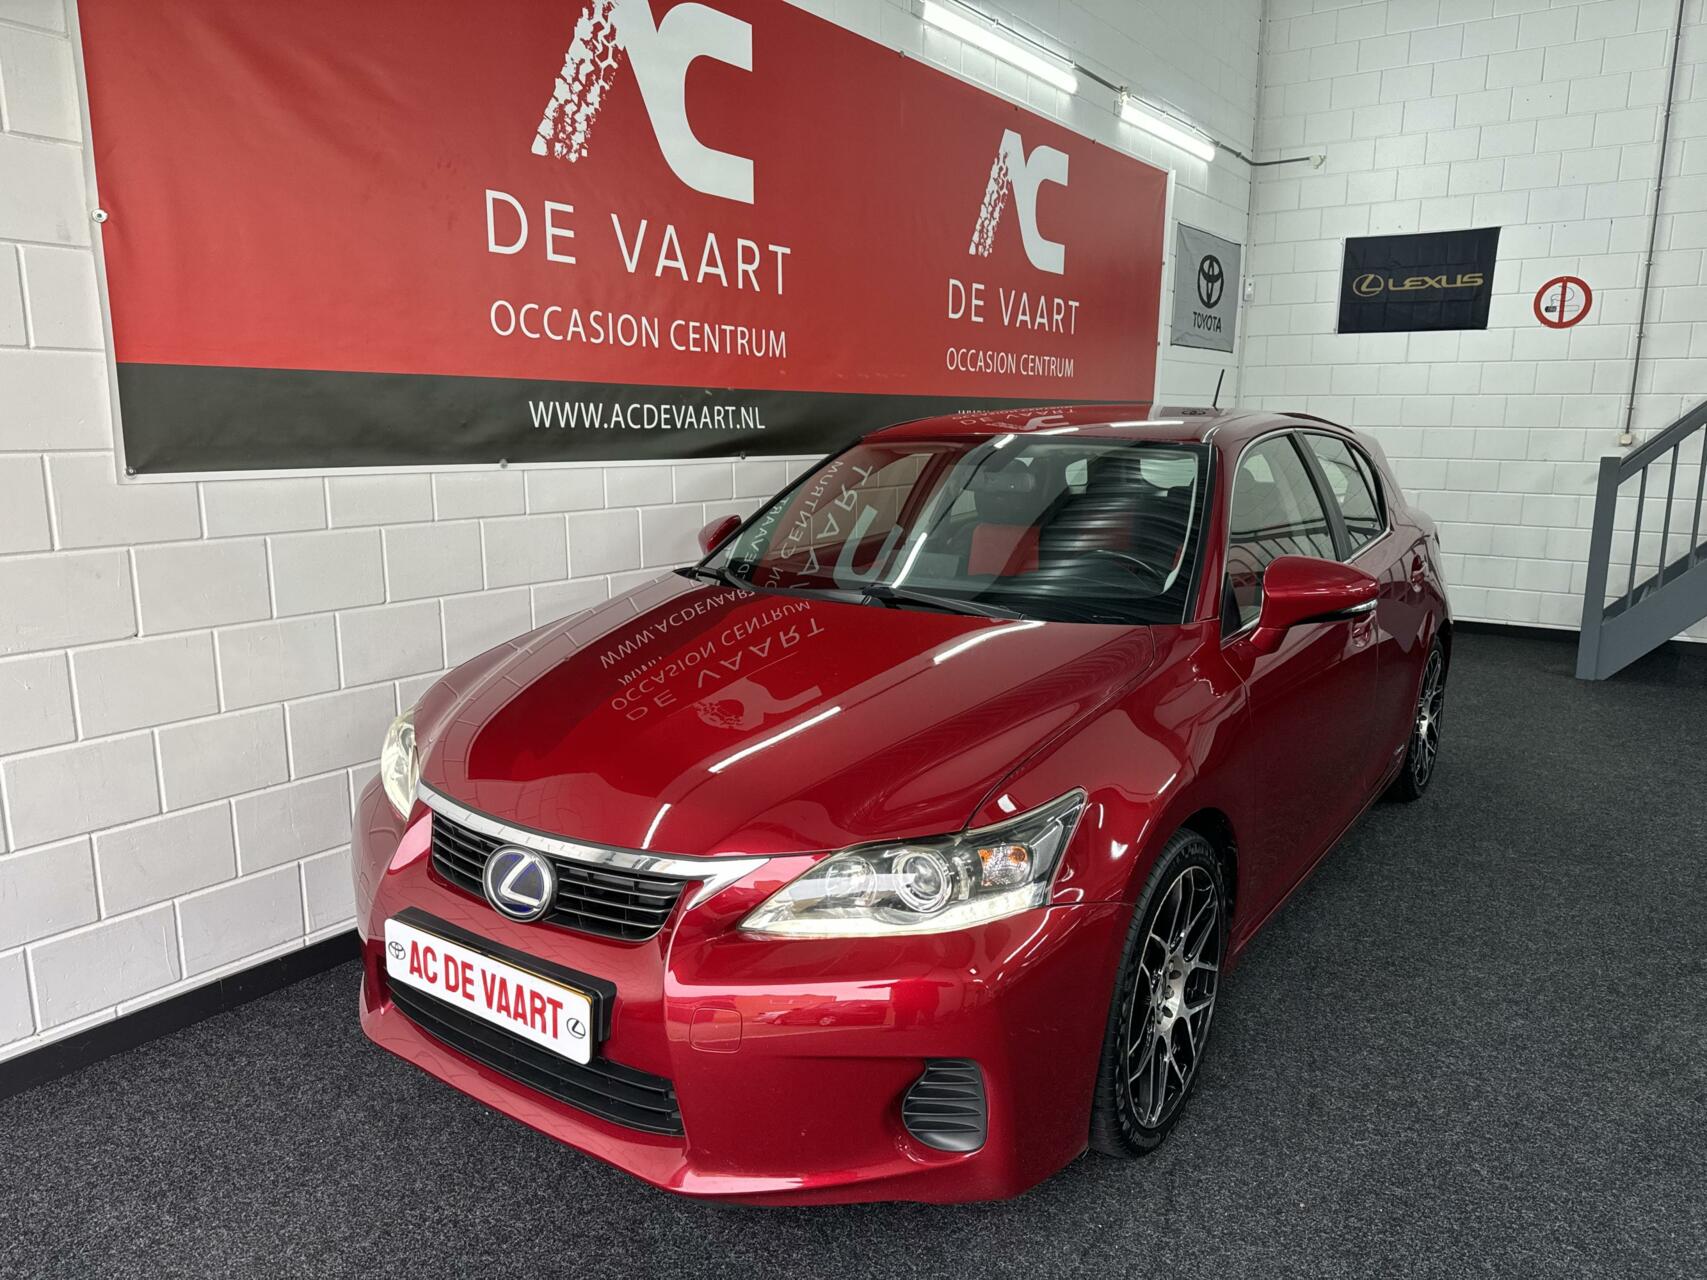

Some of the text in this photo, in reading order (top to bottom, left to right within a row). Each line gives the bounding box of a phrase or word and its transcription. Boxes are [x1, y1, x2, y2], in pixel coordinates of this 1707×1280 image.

[485, 189, 791, 295] DE VAART
[1388, 272, 1484, 291] LEXUS
[948, 278, 1080, 335] DE VAART
[1192, 311, 1222, 333] TOYOTA
[490, 300, 787, 359] OCCASION CENTRUM
[946, 347, 1074, 377] OCCASION CENTRUM
[529, 400, 766, 430] WWW.ACDEVAART.NL
[409, 940, 564, 1039] AC DE VAART
